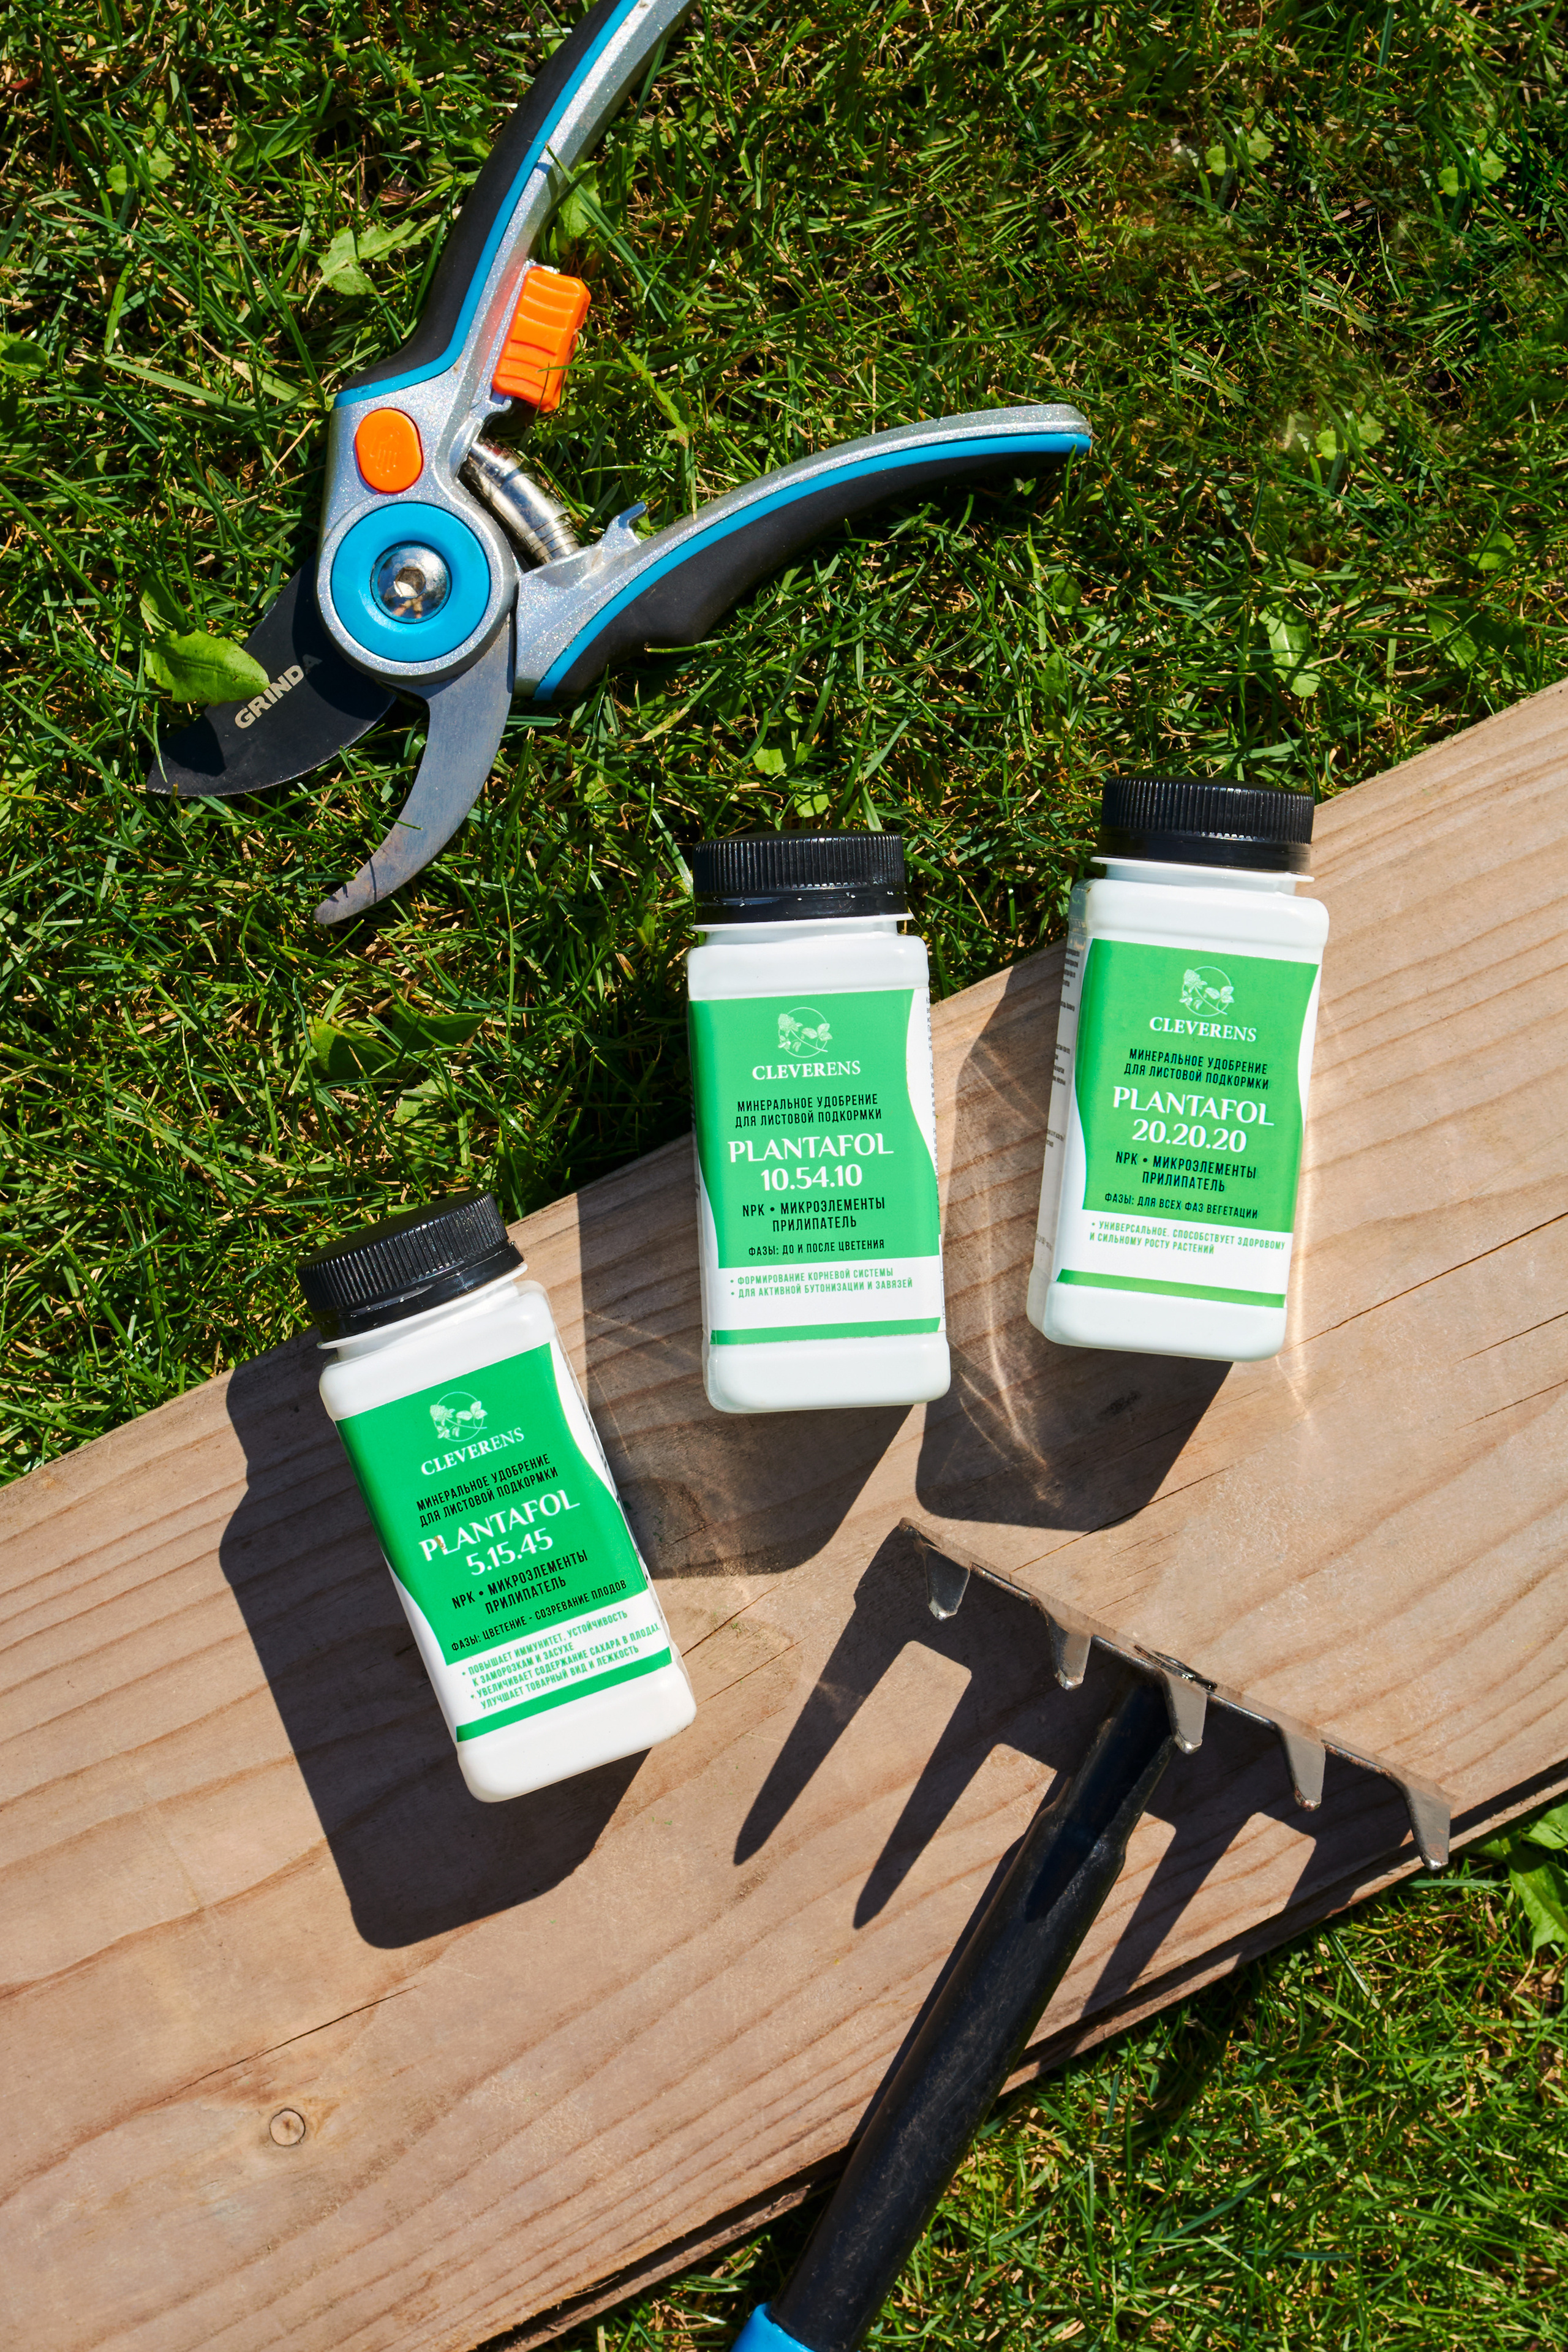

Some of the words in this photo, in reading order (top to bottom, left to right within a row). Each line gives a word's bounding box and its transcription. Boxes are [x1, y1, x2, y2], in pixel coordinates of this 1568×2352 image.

[235, 654, 323, 729] GRINDA
[1149, 1016, 1257, 1042] CLEVERENS
[752, 1060, 861, 1080] CLEVERENS
[1129, 1048, 1204, 1068] МИНЕРАЛЬНОЕ
[1208, 1057, 1268, 1074] УДОБРЕНИЕ
[1124, 1063, 1145, 1076] ДЛЯ
[1148, 1066, 1202, 1082] ЛИСТОВОЙ
[1205, 1072, 1269, 1090] ПОДКОРМКИ
[737, 1097, 813, 1112] МИНЕРАЛЬНОЕ
[817, 1093, 878, 1108] УДОБРЕНИЕ
[1113, 1086, 1275, 1126] PLANTAFOL
[735, 1115, 756, 1128] ДЛЯ
[760, 1110, 814, 1126] ЛИСТОВОЙ
[818, 1109, 882, 1123] ПОДКОРМКИ
[728, 1133, 894, 1163] PLANTAFOL
[1132, 1118, 1247, 1153] 20.20.20
[761, 1164, 862, 1191] 10.54.10
[1115, 1151, 1138, 1166] NPK
[1153, 1155, 1256, 1179] МИКРОЭЛЕМЕНТЫ
[1142, 1171, 1225, 1192] ПРИЛИПАТЕЛЬ
[742, 1204, 765, 1217] NPK
[780, 1197, 885, 1215] МИКРОЭЛЕМЕНТЫ
[1104, 1193, 1134, 1205] ФАЗЫ:
[1137, 1196, 1156, 1207] ДЛЯ
[1159, 1199, 1182, 1210] ВСЕХ
[1185, 1202, 1204, 1212] ФАЗ
[1207, 1204, 1258, 1219] ВЕГЕТАЦИИ
[772, 1215, 857, 1232] ПРИЛИПАТЕЛЬ
[748, 1246, 779, 1256] ФАЗЫ:
[782, 1244, 794, 1256] ДО
[797, 1244, 803, 1253] И
[807, 1242, 835, 1253] ПОСЛЕ
[839, 1239, 884, 1252] ЦВЕТЕНИЯ
[1090, 1232, 1095, 1241] И
[1098, 1233, 1142, 1246] СИЛЬНОМУ
[1145, 1239, 1170, 1250] РОСТУ
[1172, 1242, 1215, 1254] РАСТЕНИЙ
[1172, 1229, 1235, 1245] СПОСОБСТВУЕТ
[1237, 1237, 1285, 1251] ЗДОРОВОМУ
[737, 1272, 805, 1286] ФОРМИРОВАНИЕ
[808, 1268, 850, 1281] КОРНЕВОЙ
[853, 1268, 893, 1278] СИСТЕМЫ
[738, 1288, 756, 1299] ДЛЯ
[758, 1284, 802, 1297] АКТИВНОЙ
[804, 1281, 864, 1294] БУТОНИЗАЦИИ
[867, 1281, 873, 1290] И
[875, 1277, 913, 1290] ЗАВЯЗЕЙ
[421, 1427, 525, 1476] CLEVERENS
[416, 1476, 489, 1511] МИНЕРАЛЬНОЕ
[491, 1453, 550, 1484] УДОБРЕНИЕ
[420, 1510, 441, 1528] ДЛЯ
[443, 1488, 495, 1518] ЛИСТОВОЙ
[496, 1466, 558, 1498] ПОДКОРМКИ
[418, 1490, 580, 1561] PLANTAFOL
[466, 1528, 553, 1575] 5.15.45
[451, 1591, 476, 1609] NPK
[487, 1549, 588, 1596] МИКРОЭЛЕМЕНТЫ
[485, 1575, 567, 1615] ПРИЛИПАТЕЛЬ
[451, 1635, 481, 1652] ФАЗЫ:
[482, 1616, 527, 1640] ЦВЕТЕНИЕ
[535, 1593, 590, 1620] СОЗРЕВАНИЕ
[591, 1580, 627, 1599] ПЛОДОВ
[468, 1651, 513, 1676] ПОВЫШАЕТ
[567, 1610, 628, 1638] УСТОЙЧИВОСТЬ
[472, 1678, 479, 1687] К
[480, 1656, 535, 1684] ЗАМОРОЗКАМ
[535, 1654, 541, 1663] И
[543, 1642, 574, 1659] ЗАСУХЕ
[477, 1670, 533, 1698] УВЕЛИЧИВАЕТ
[534, 1648, 588, 1676] СОДЕРЖАНИЕ
[589, 1639, 620, 1656] САХАРА
[623, 1635, 628, 1644] В
[481, 1686, 524, 1709] УЛУЧШАЕТ
[525, 1668, 568, 1693] ТОВАРНЫЙ
[571, 1664, 588, 1676] ВИД
[589, 1660, 595, 1669] И
[597, 1646, 639, 1667] ЛЕЖКОСТЬ
